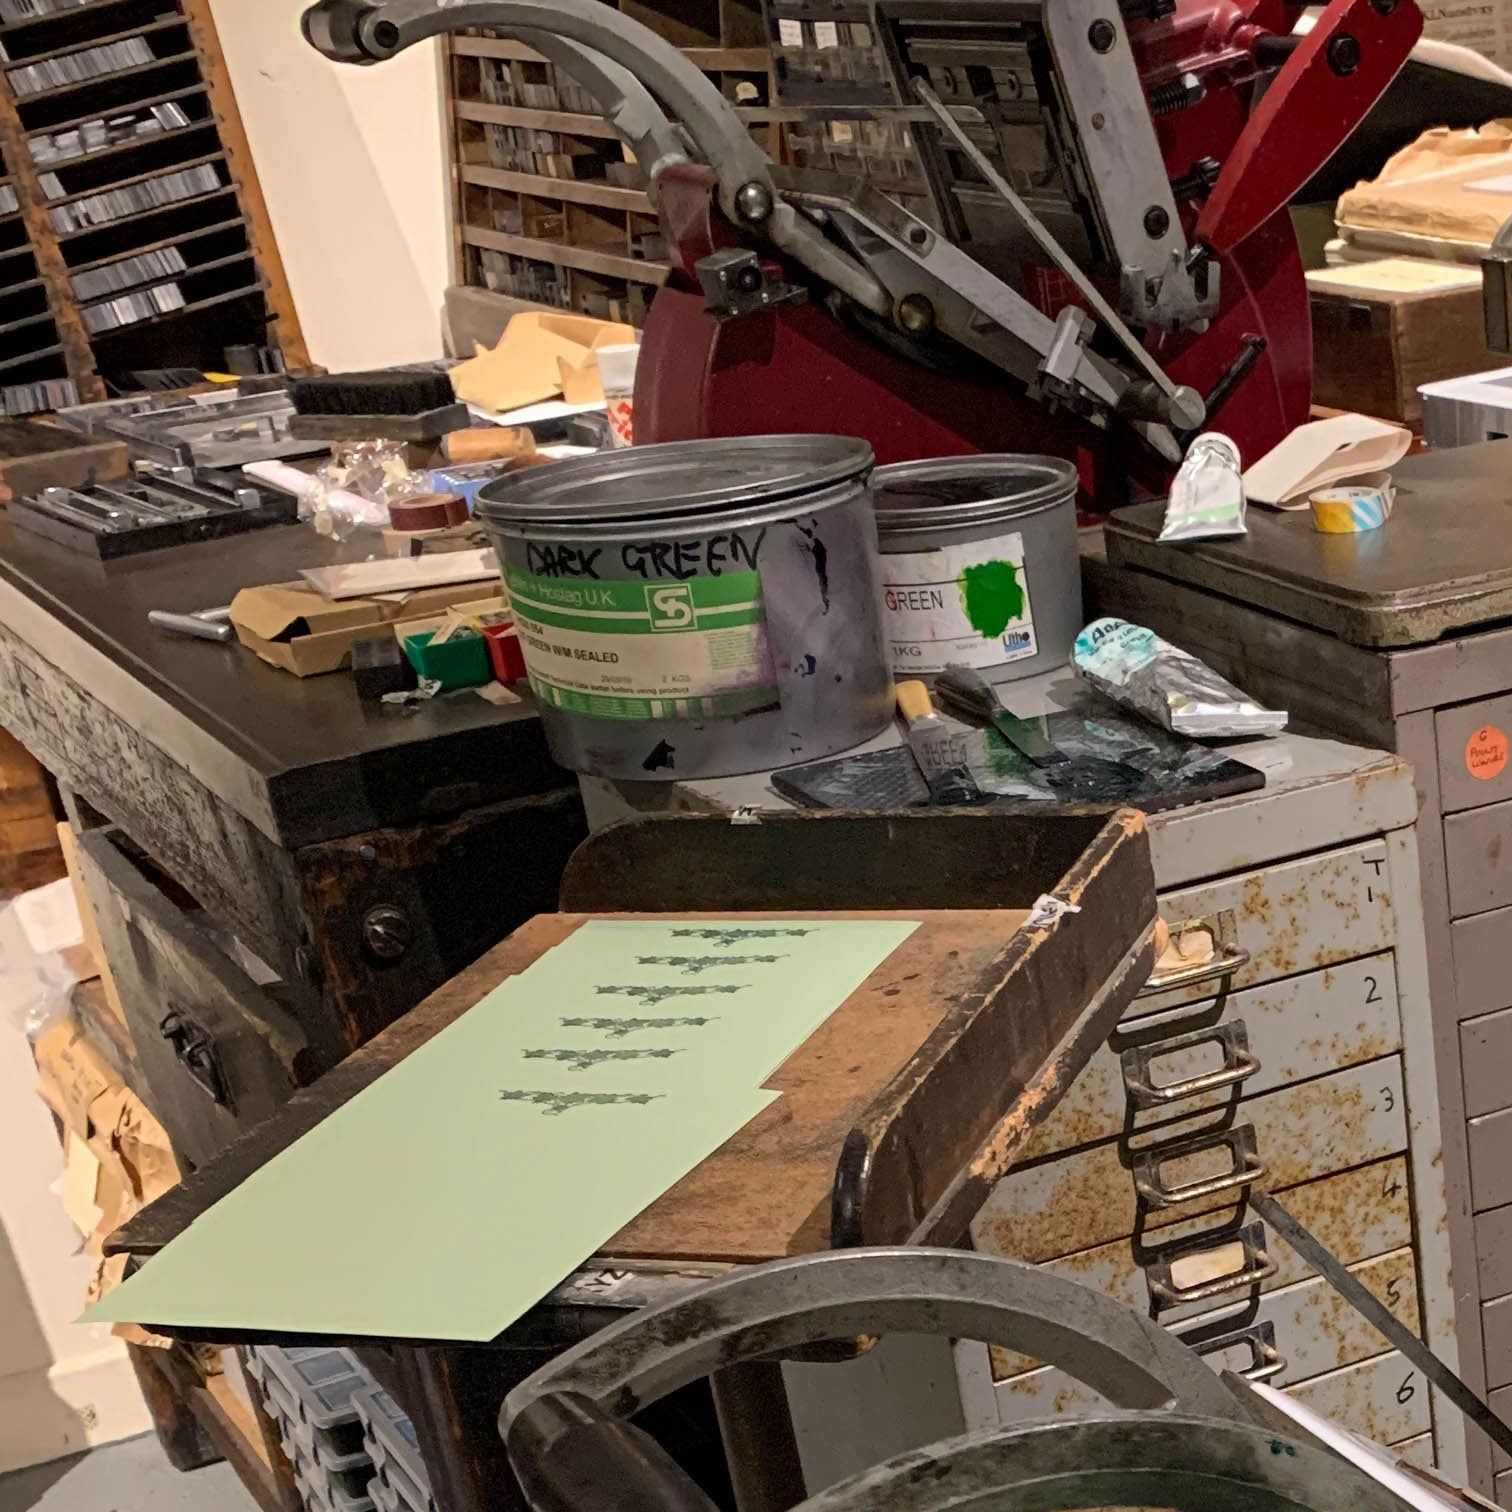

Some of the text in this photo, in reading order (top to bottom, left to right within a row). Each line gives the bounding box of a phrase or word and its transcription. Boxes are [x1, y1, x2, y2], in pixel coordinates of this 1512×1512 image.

[526, 528, 766, 580] DARK GREEN
[884, 589, 945, 612] GREEN
[574, 647, 620, 664] SEALED
[1364, 976, 1383, 1005] 2
[1379, 1086, 1395, 1113] 3
[1380, 1172, 1403, 1199] 4
[1386, 1278, 1401, 1308] 5
[1395, 1371, 1415, 1405] 6
